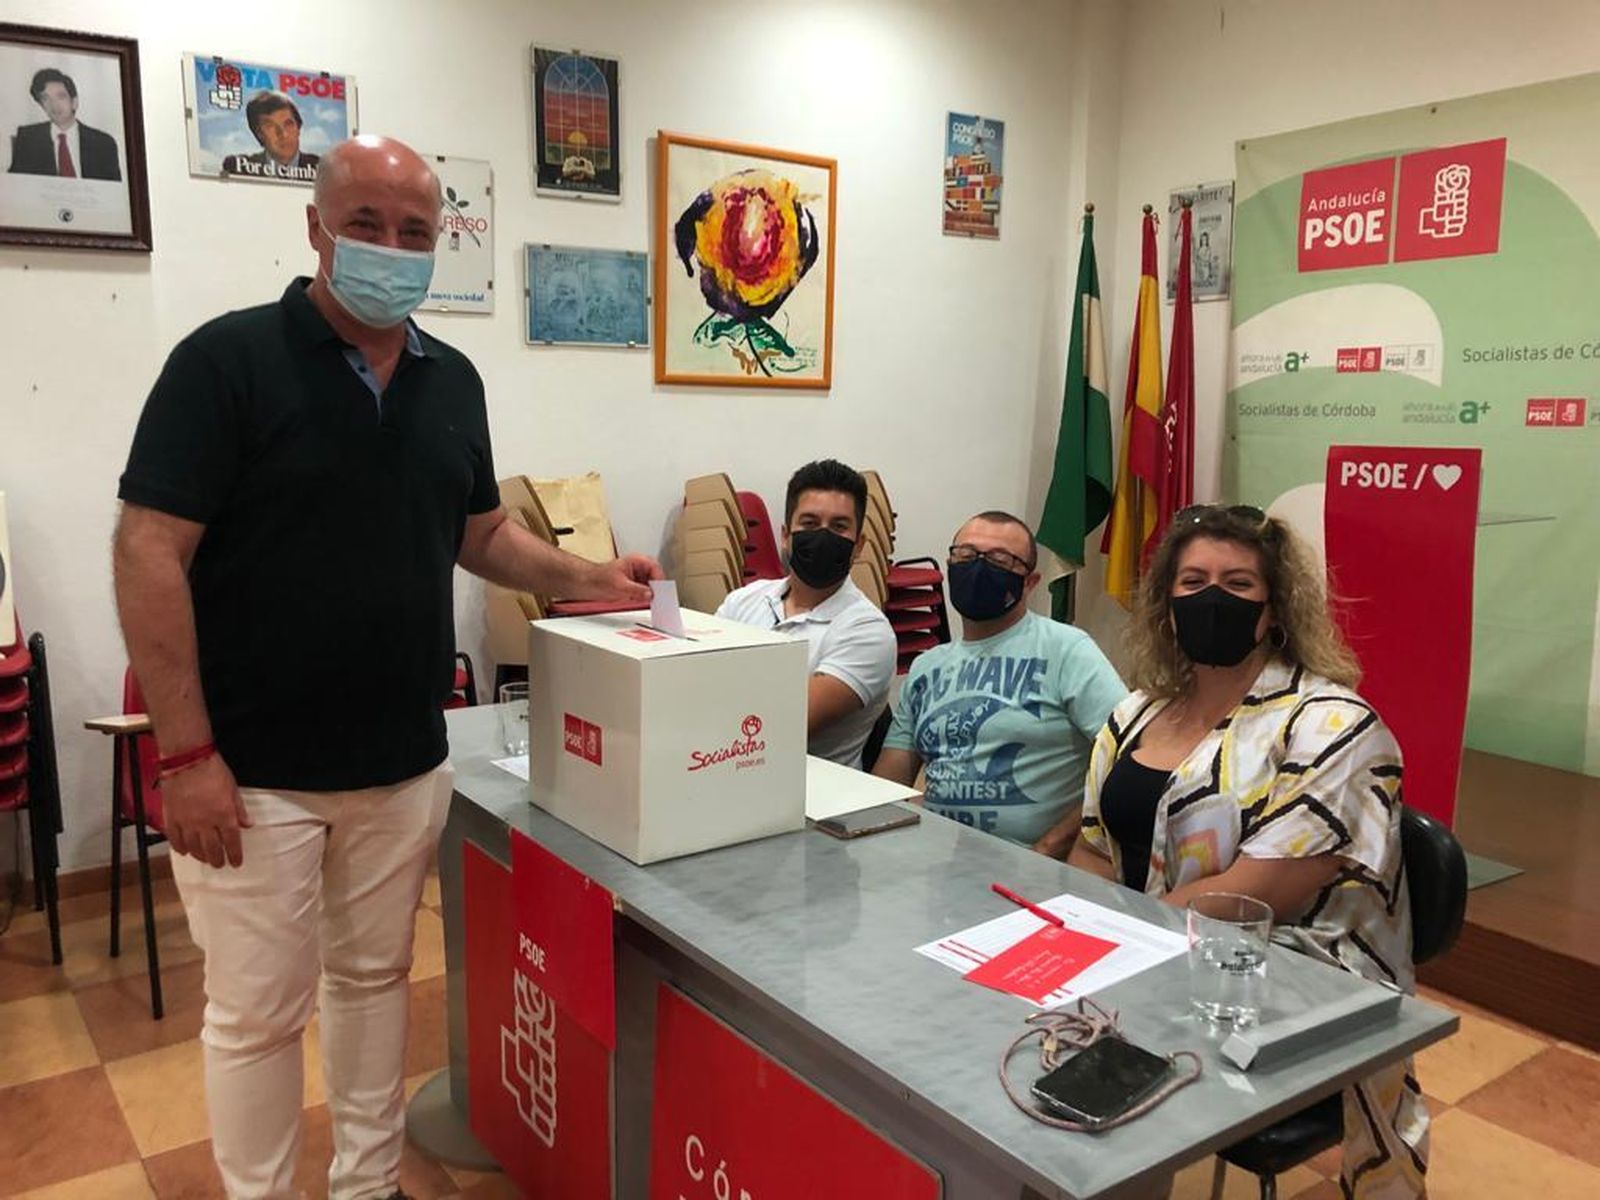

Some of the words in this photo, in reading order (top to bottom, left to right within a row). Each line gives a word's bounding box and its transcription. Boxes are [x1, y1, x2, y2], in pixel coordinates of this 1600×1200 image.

[279, 74, 346, 101] PSOE
[235, 156, 263, 173] Por
[264, 161, 275, 174] el
[278, 164, 320, 178] camb
[1308, 187, 1386, 212] Andalucía
[443, 215, 488, 232] RESO
[1304, 209, 1385, 250] PSOE
[1462, 347, 1548, 363] Socialistas
[1553, 344, 1575, 360] de
[1238, 403, 1300, 417] Socialistas
[1302, 403, 1319, 417] de
[1322, 402, 1376, 417] Córdoba
[1341, 461, 1408, 489] PSOE
[955, 656, 1048, 700] WAVE
[687, 736, 765, 771] Socialistas
[519, 932, 547, 974] PSOE
